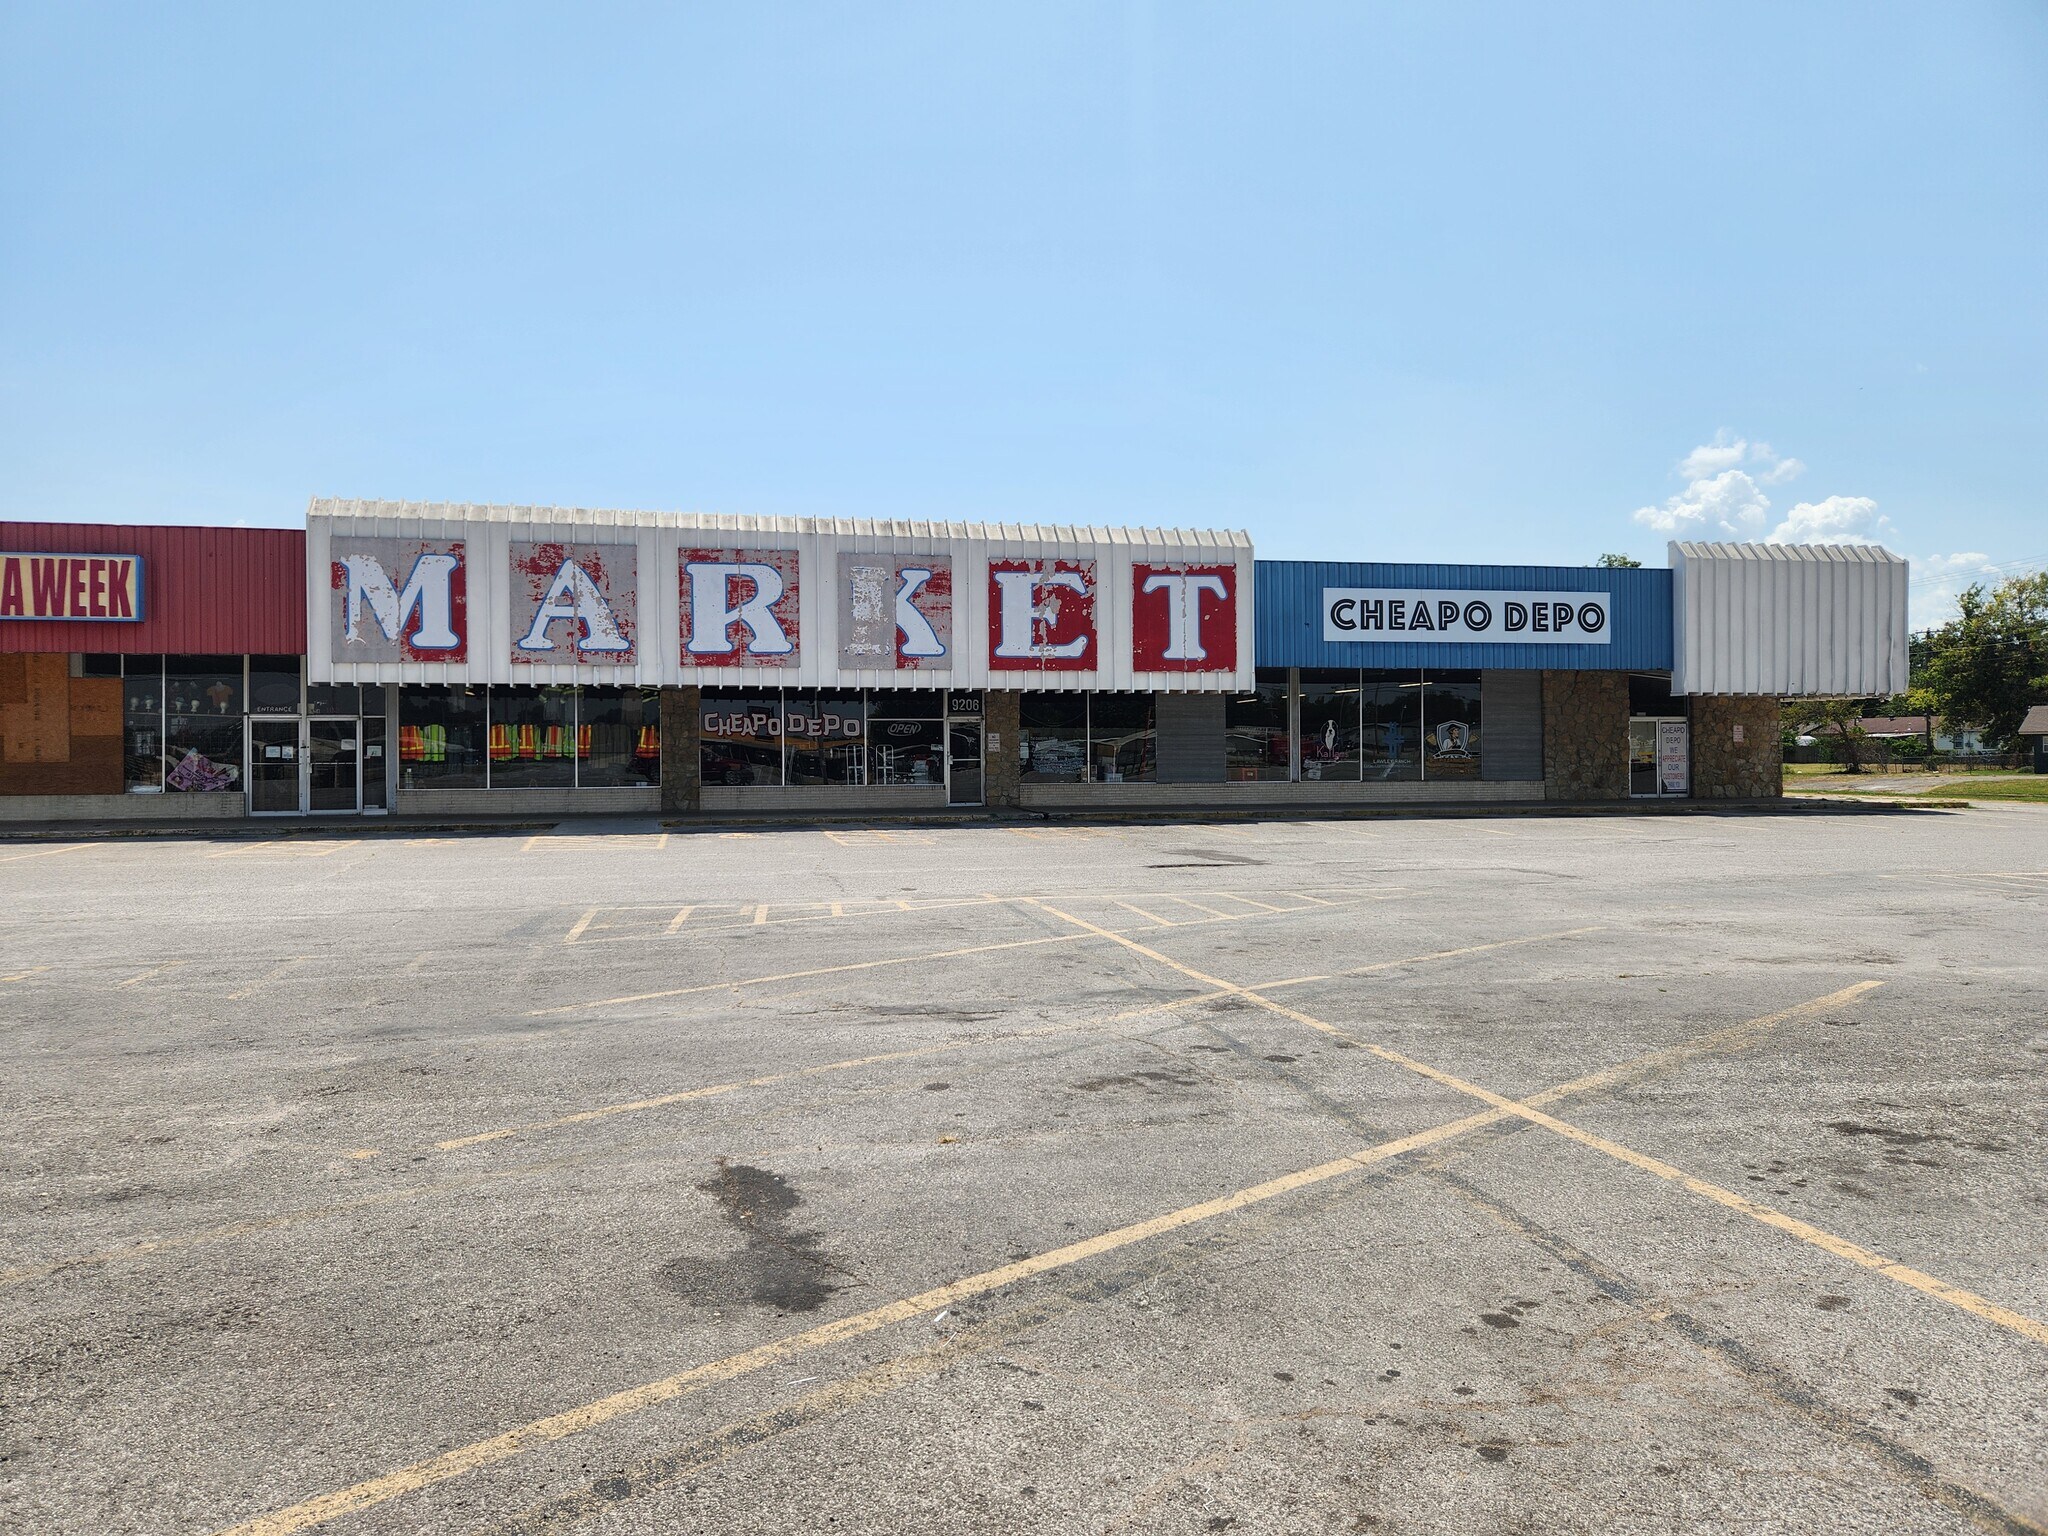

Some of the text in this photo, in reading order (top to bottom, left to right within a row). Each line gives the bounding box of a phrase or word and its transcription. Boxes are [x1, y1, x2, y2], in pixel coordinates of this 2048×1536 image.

[1, 557, 133, 617] A WEEK
[339, 552, 1228, 660] MARKET
[1330, 598, 1606, 633] CHEAPO DEPO
[256, 705, 292, 713] ENTRANCE
[951, 699, 980, 711] 9206
[704, 712, 862, 737] CHEAPO DEPO
[889, 723, 919, 734] OPEN
[1662, 726, 1686, 734] CHEAPO
[1667, 763, 1680, 771] OUR
